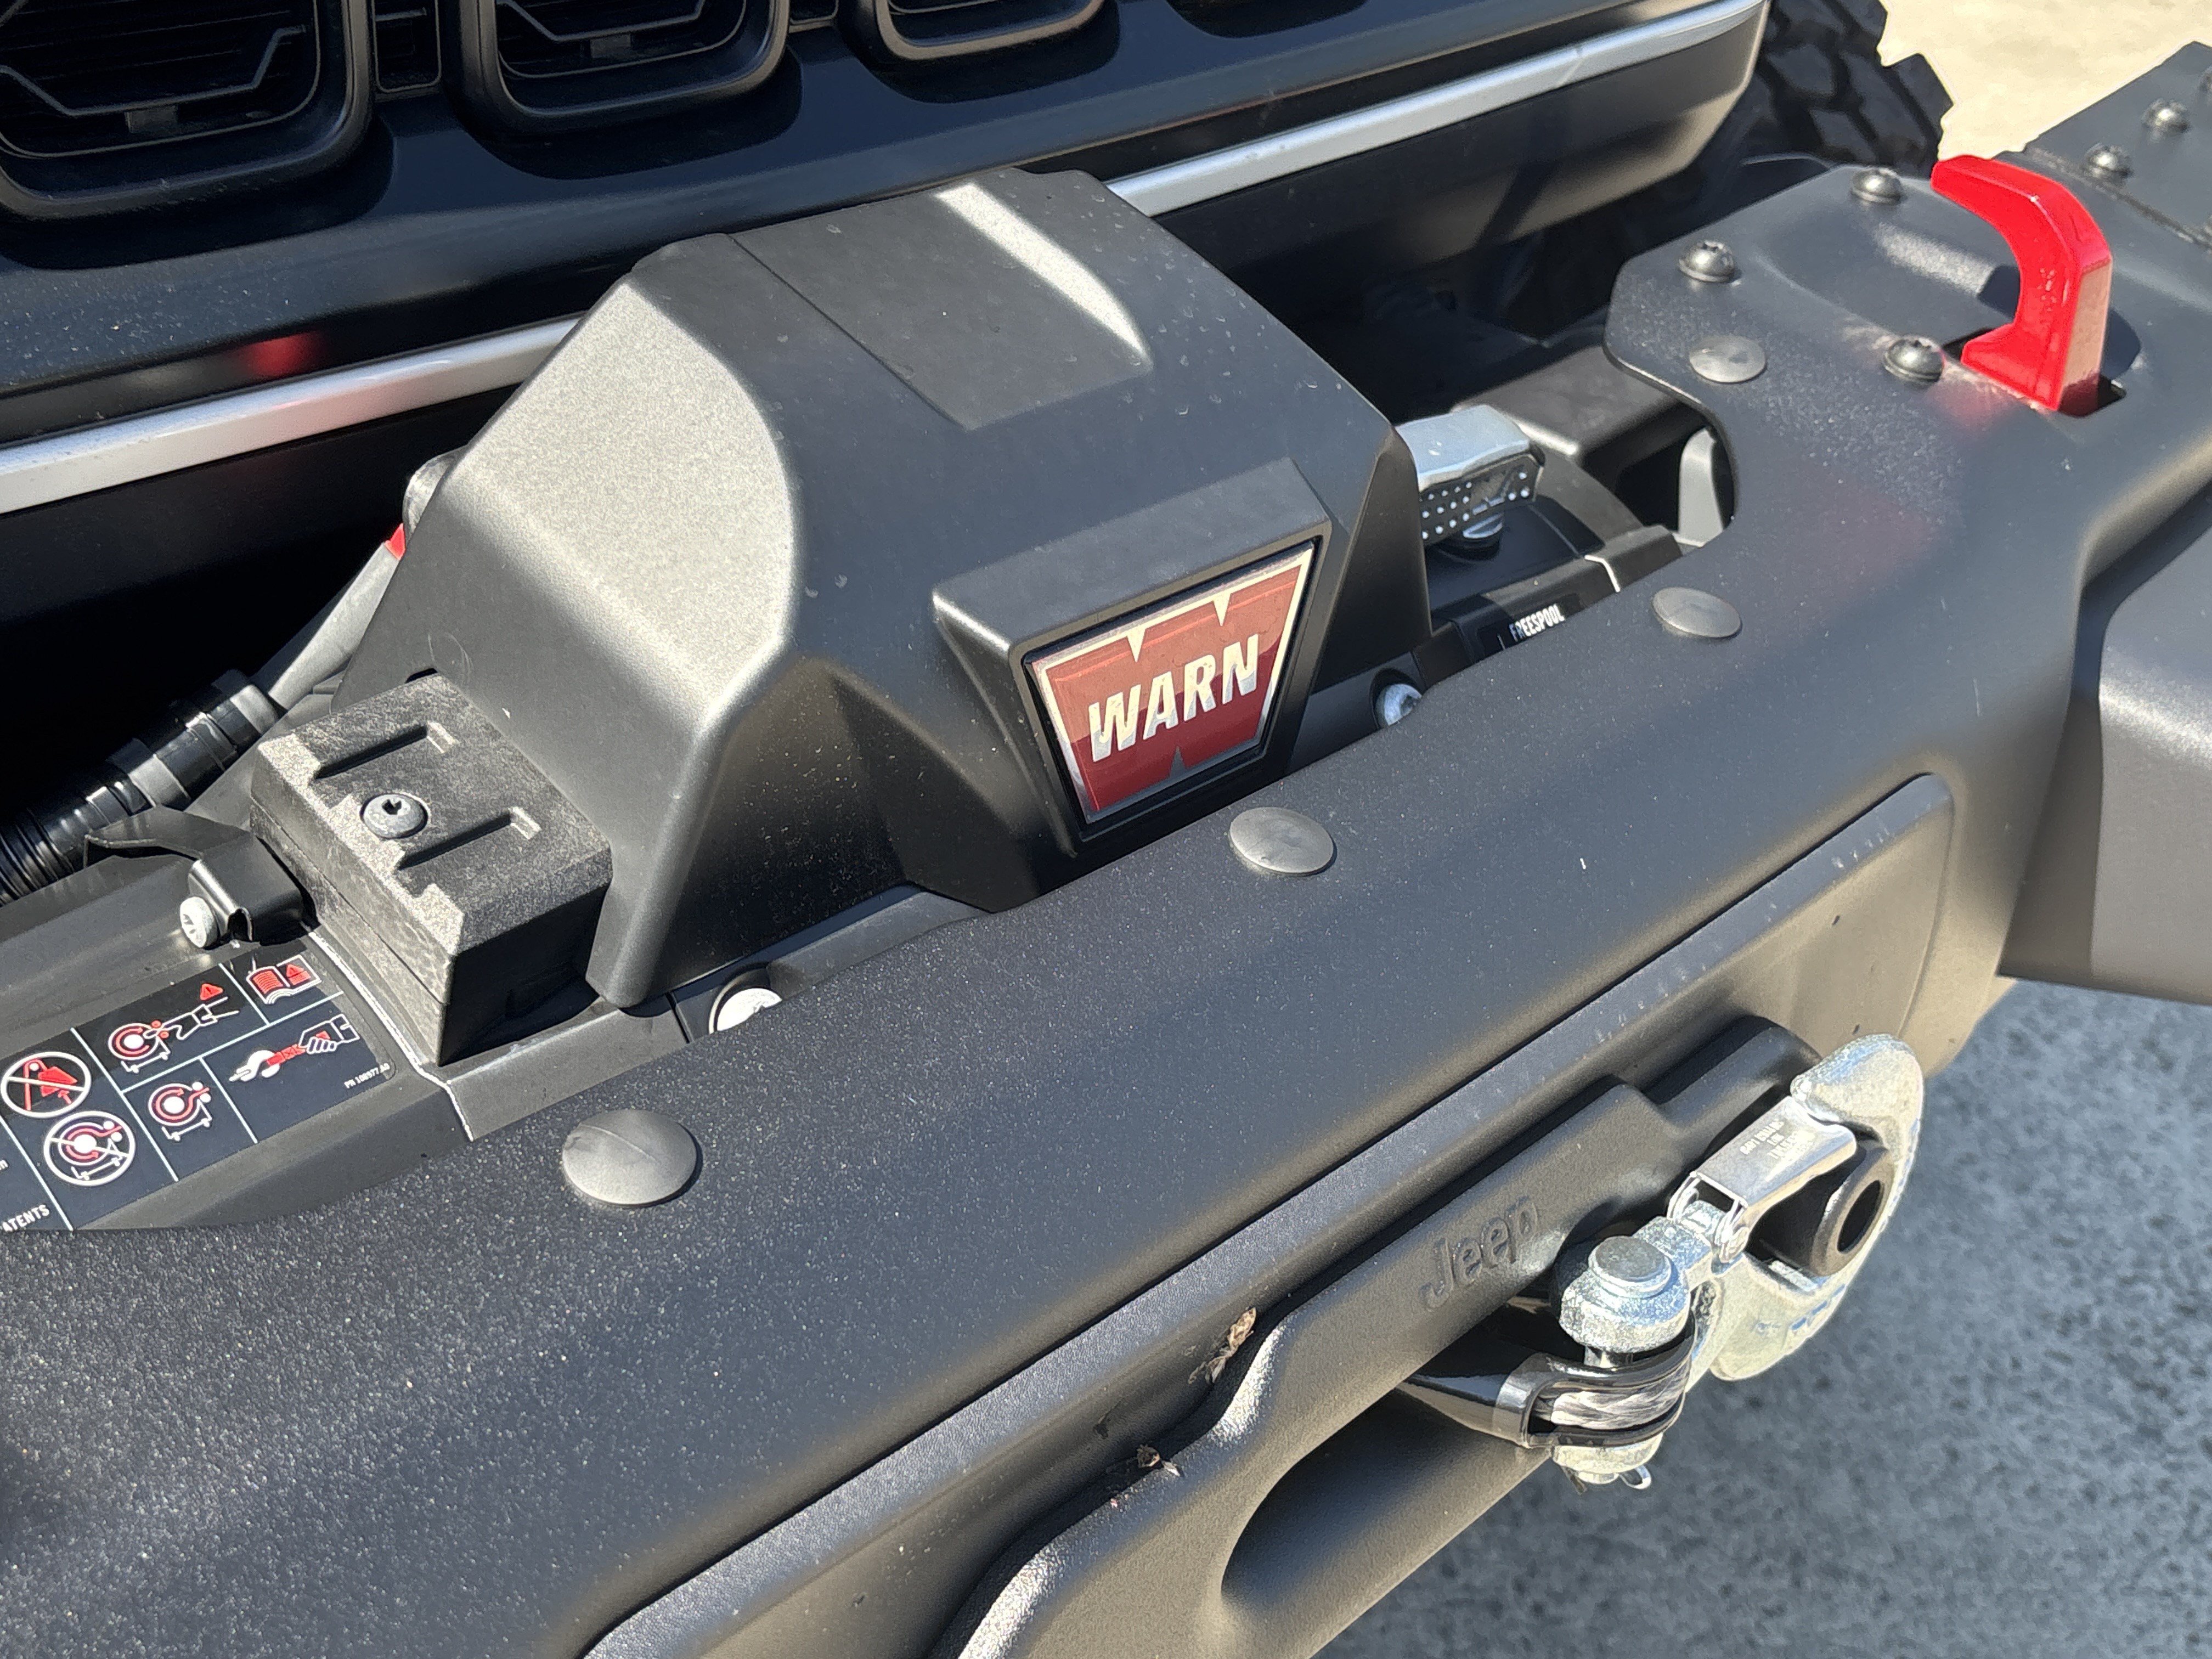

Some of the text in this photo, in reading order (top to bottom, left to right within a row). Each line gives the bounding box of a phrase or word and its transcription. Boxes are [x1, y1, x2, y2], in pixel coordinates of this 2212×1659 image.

[1508, 603, 1565, 642] FREESPOOL
[1088, 634, 1259, 763] WARN
[0, 1204, 50, 1232] ATENTS
[1417, 1195, 1538, 1311] Jeep
